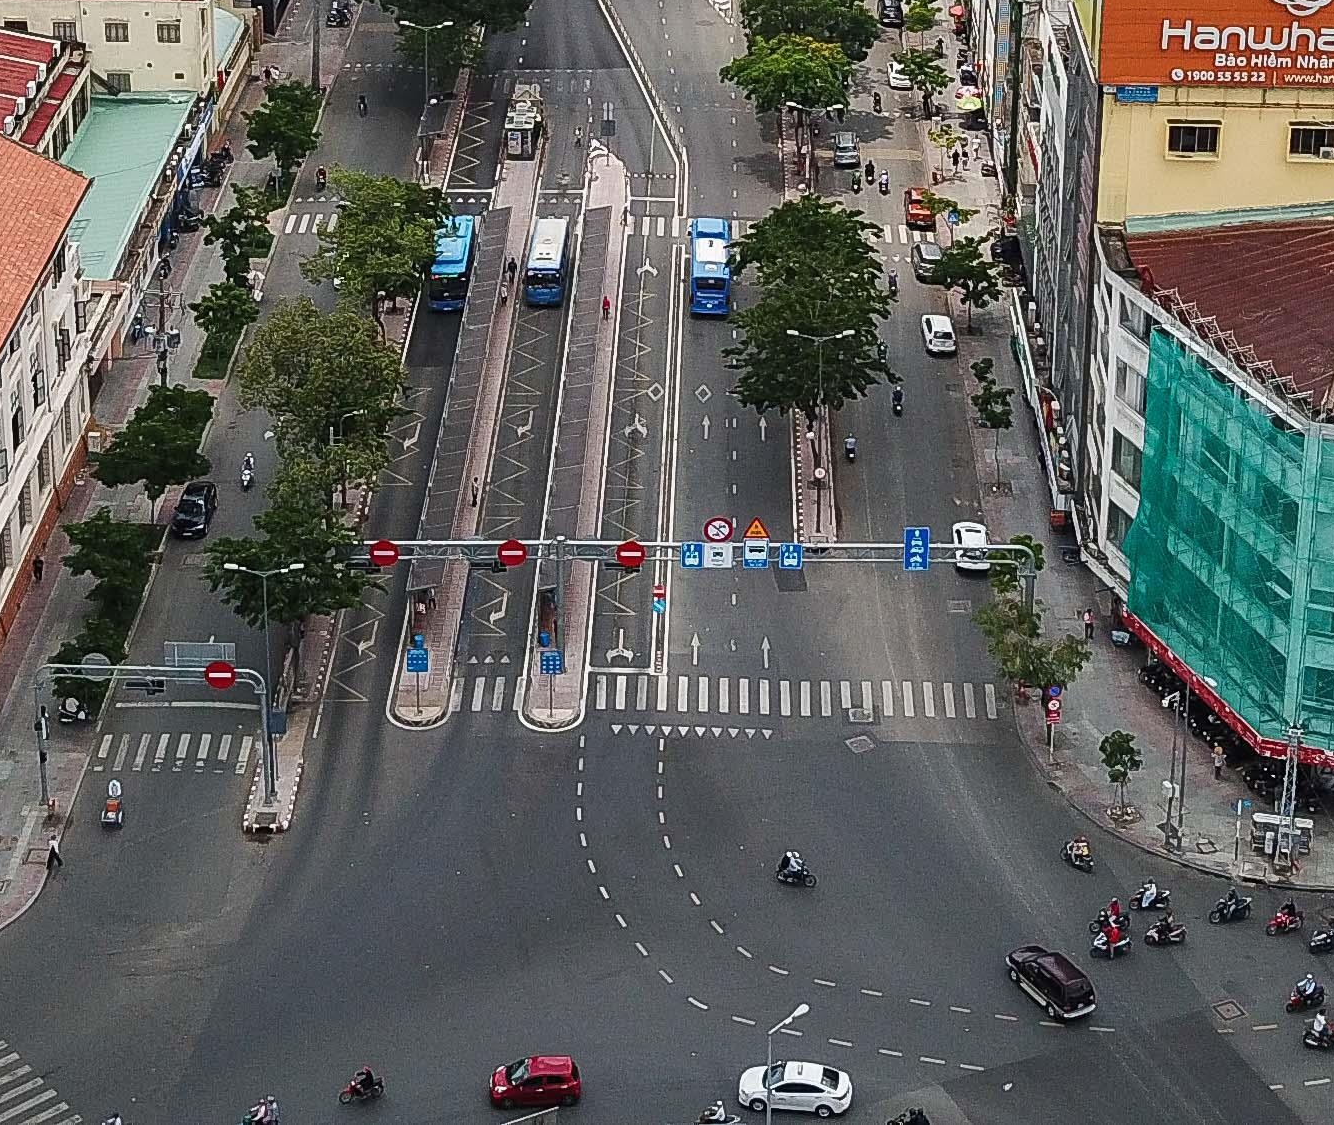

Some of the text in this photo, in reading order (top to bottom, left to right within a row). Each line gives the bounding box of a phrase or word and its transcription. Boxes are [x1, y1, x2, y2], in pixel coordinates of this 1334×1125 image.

[1215, 53, 1247, 68] Bảo
[1186, 70, 1215, 82] 1900
[1217, 71, 1232, 82] 55
[1233, 71, 1248, 82] 55
[1250, 71, 1265, 82] 22
